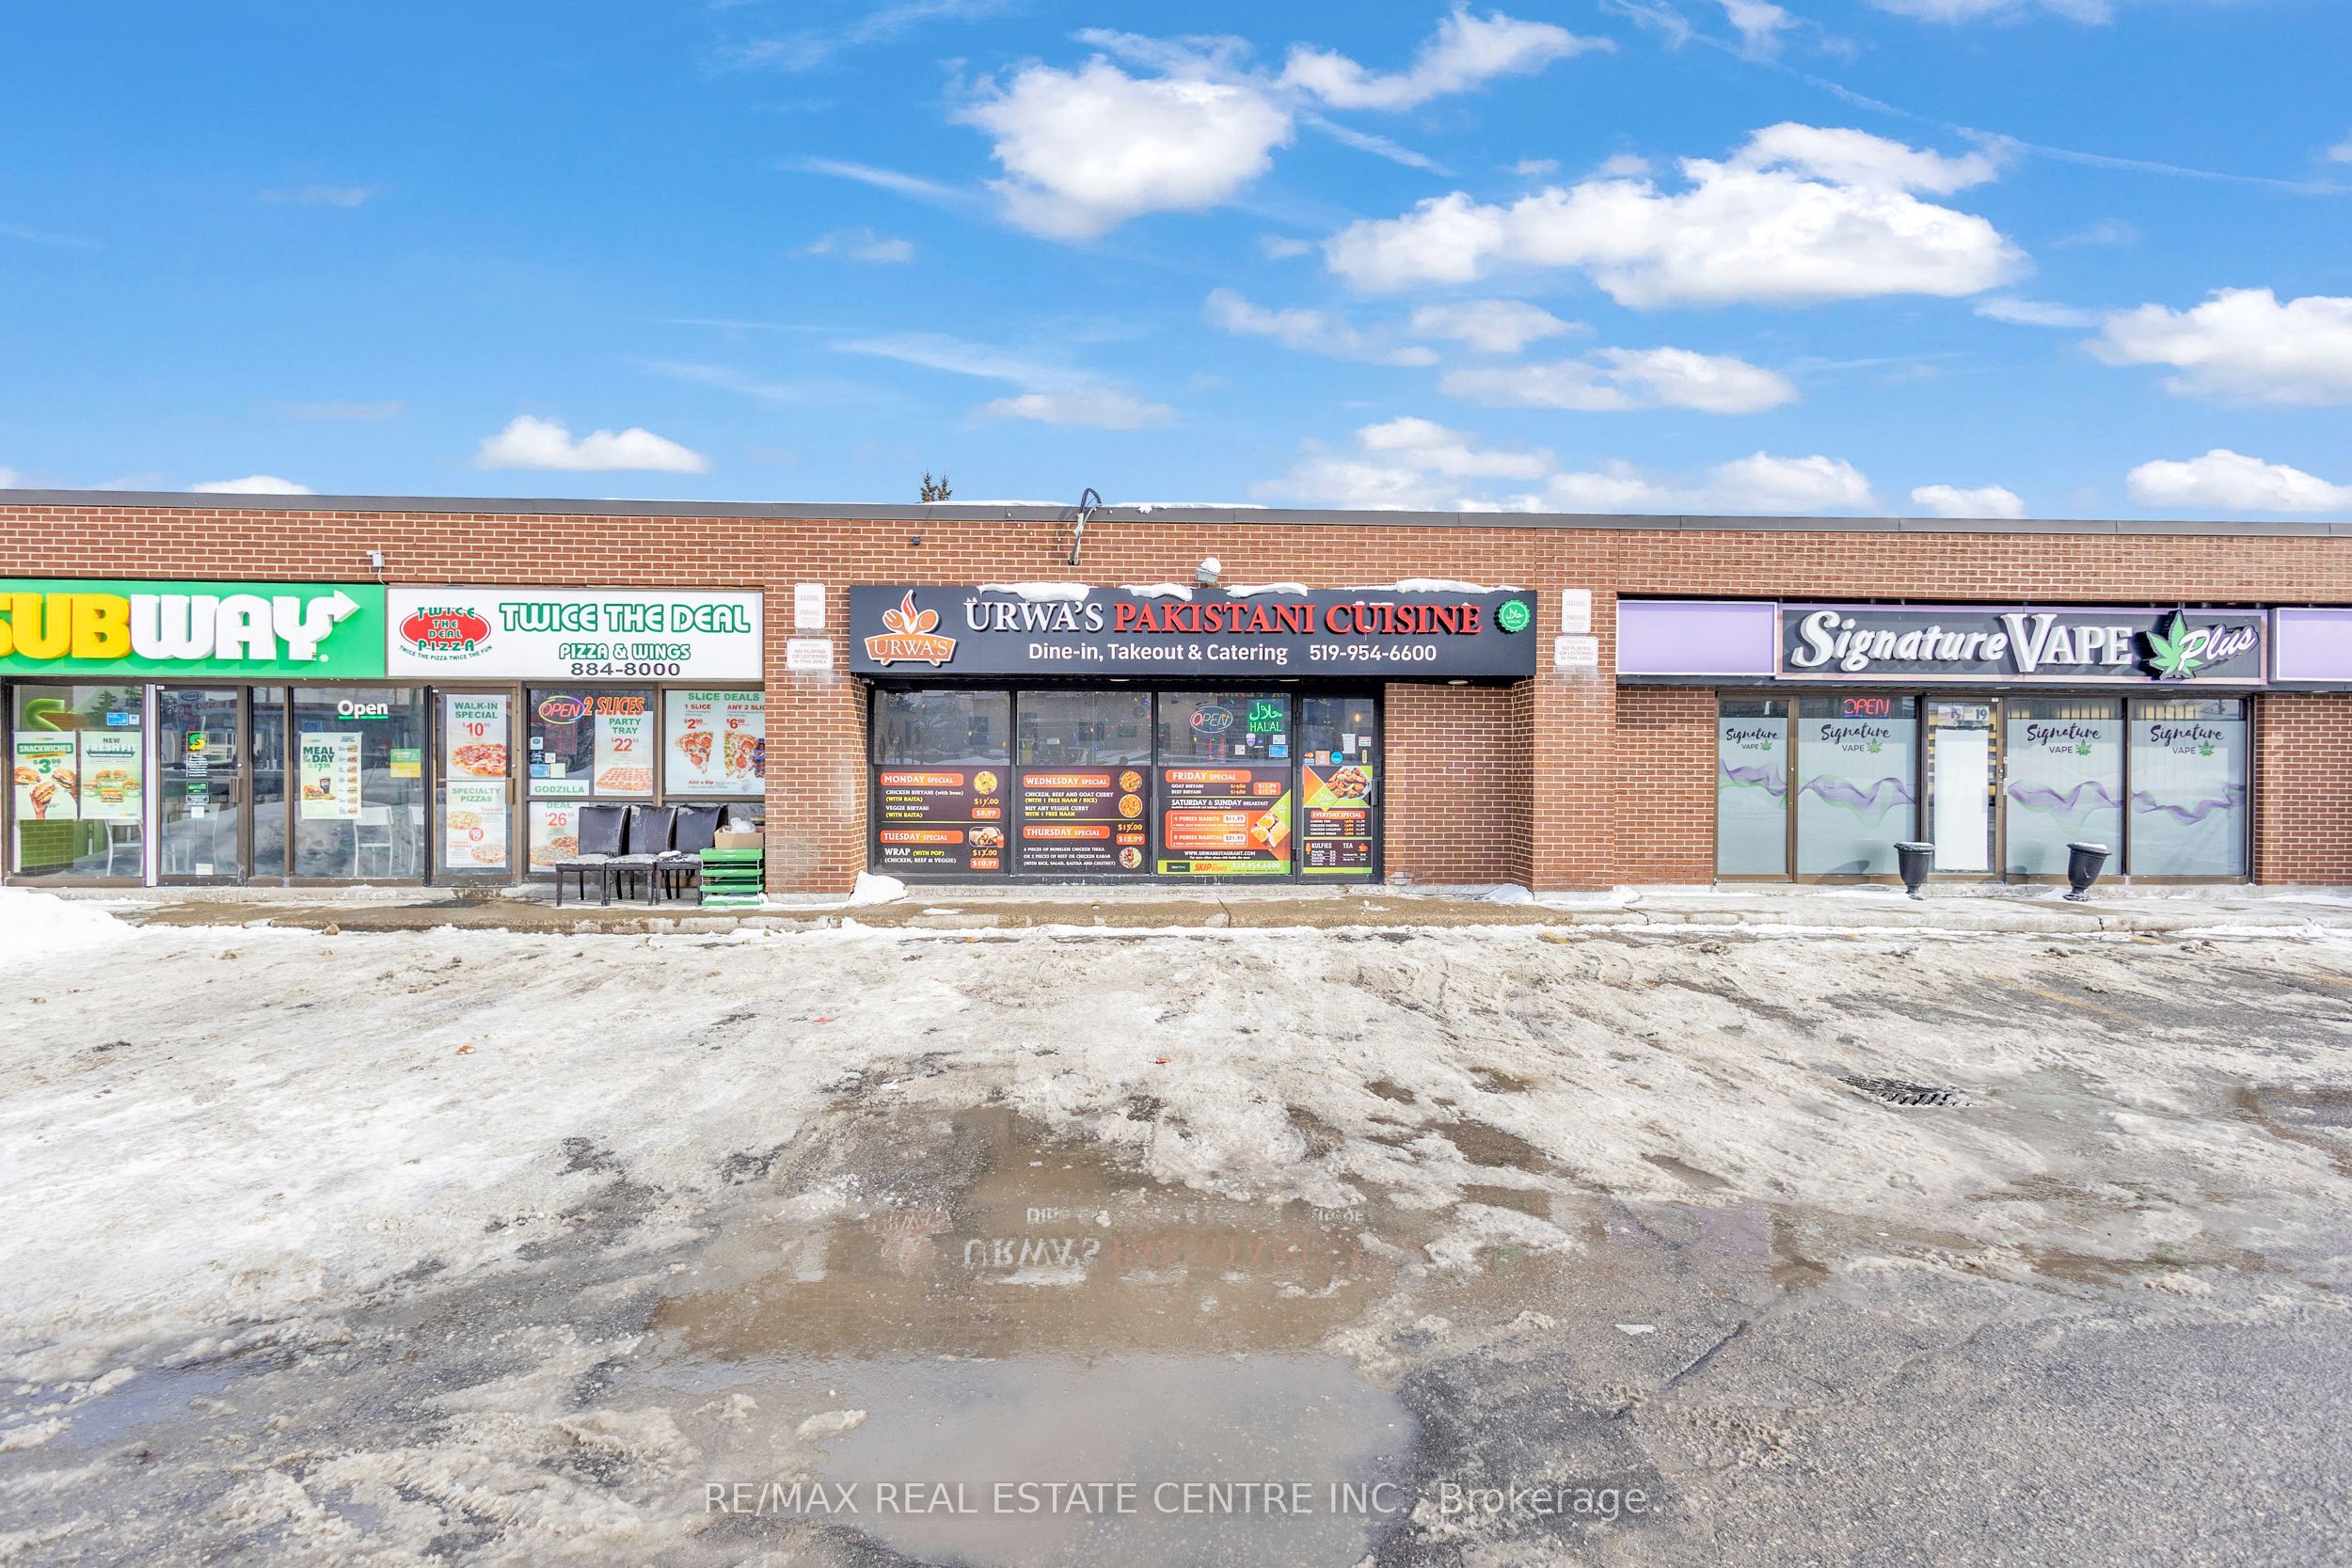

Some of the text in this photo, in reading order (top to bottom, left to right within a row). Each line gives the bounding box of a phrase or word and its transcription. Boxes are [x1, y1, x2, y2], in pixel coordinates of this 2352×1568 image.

[418, 608, 474, 619] TWICE
[499, 602, 751, 633] TWICE THE DEAL
[963, 600, 1483, 635] URWA'S PAKISTANI CUISINE
[1506, 608, 1523, 619] حلال
[0, 590, 360, 661] UBWAY
[419, 640, 474, 651] PIZZA
[873, 639, 948, 657] URWA'S
[1790, 610, 2258, 673] Signature VAPE Plus
[399, 645, 415, 657] TWICE
[482, 645, 492, 654] FUN
[559, 643, 691, 660] PIZZA & WINGS
[1028, 643, 1437, 665] Dine-in, Takeout & Catering 519-954-6600
[571, 663, 681, 676] 884-8000
[338, 700, 389, 719] Open
[541, 703, 581, 717] OPEN
[583, 696, 644, 716] 2 SLICES
[1249, 702, 1282, 721] حلال
[1843, 698, 1890, 717] OPEN
[1192, 713, 1229, 726] OPEN
[1249, 722, 1281, 732] HALAL
[1725, 727, 1779, 745] Signature
[1820, 722, 1891, 747] Signature
[2026, 721, 2102, 746] Signature
[2150, 722, 2224, 747] Signature
[1842, 744, 1865, 752] VAPE
